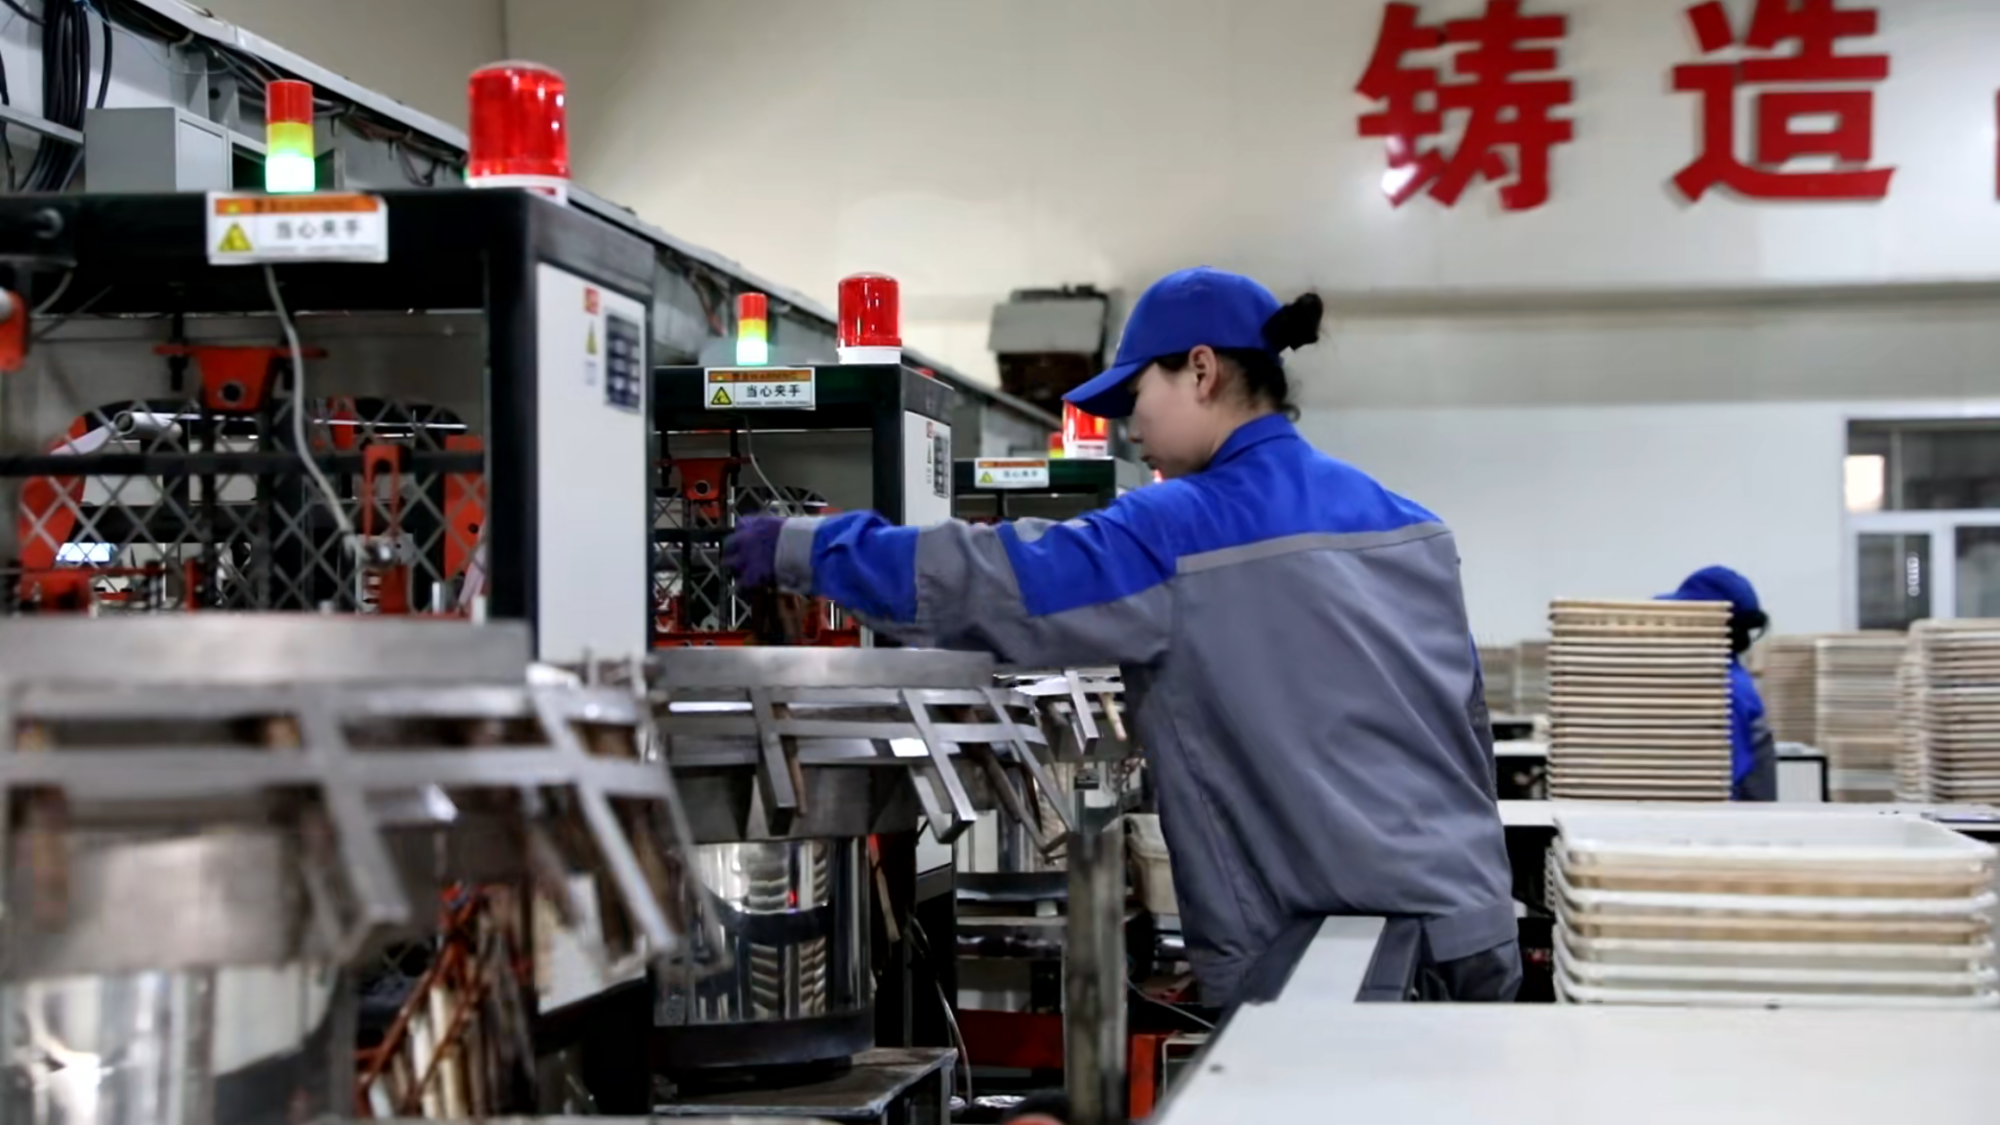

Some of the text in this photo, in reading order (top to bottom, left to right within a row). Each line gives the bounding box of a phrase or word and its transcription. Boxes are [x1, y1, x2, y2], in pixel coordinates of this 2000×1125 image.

[1354, 0, 2000, 211] 铸造
[746, 384, 800, 398] 当心夹手
